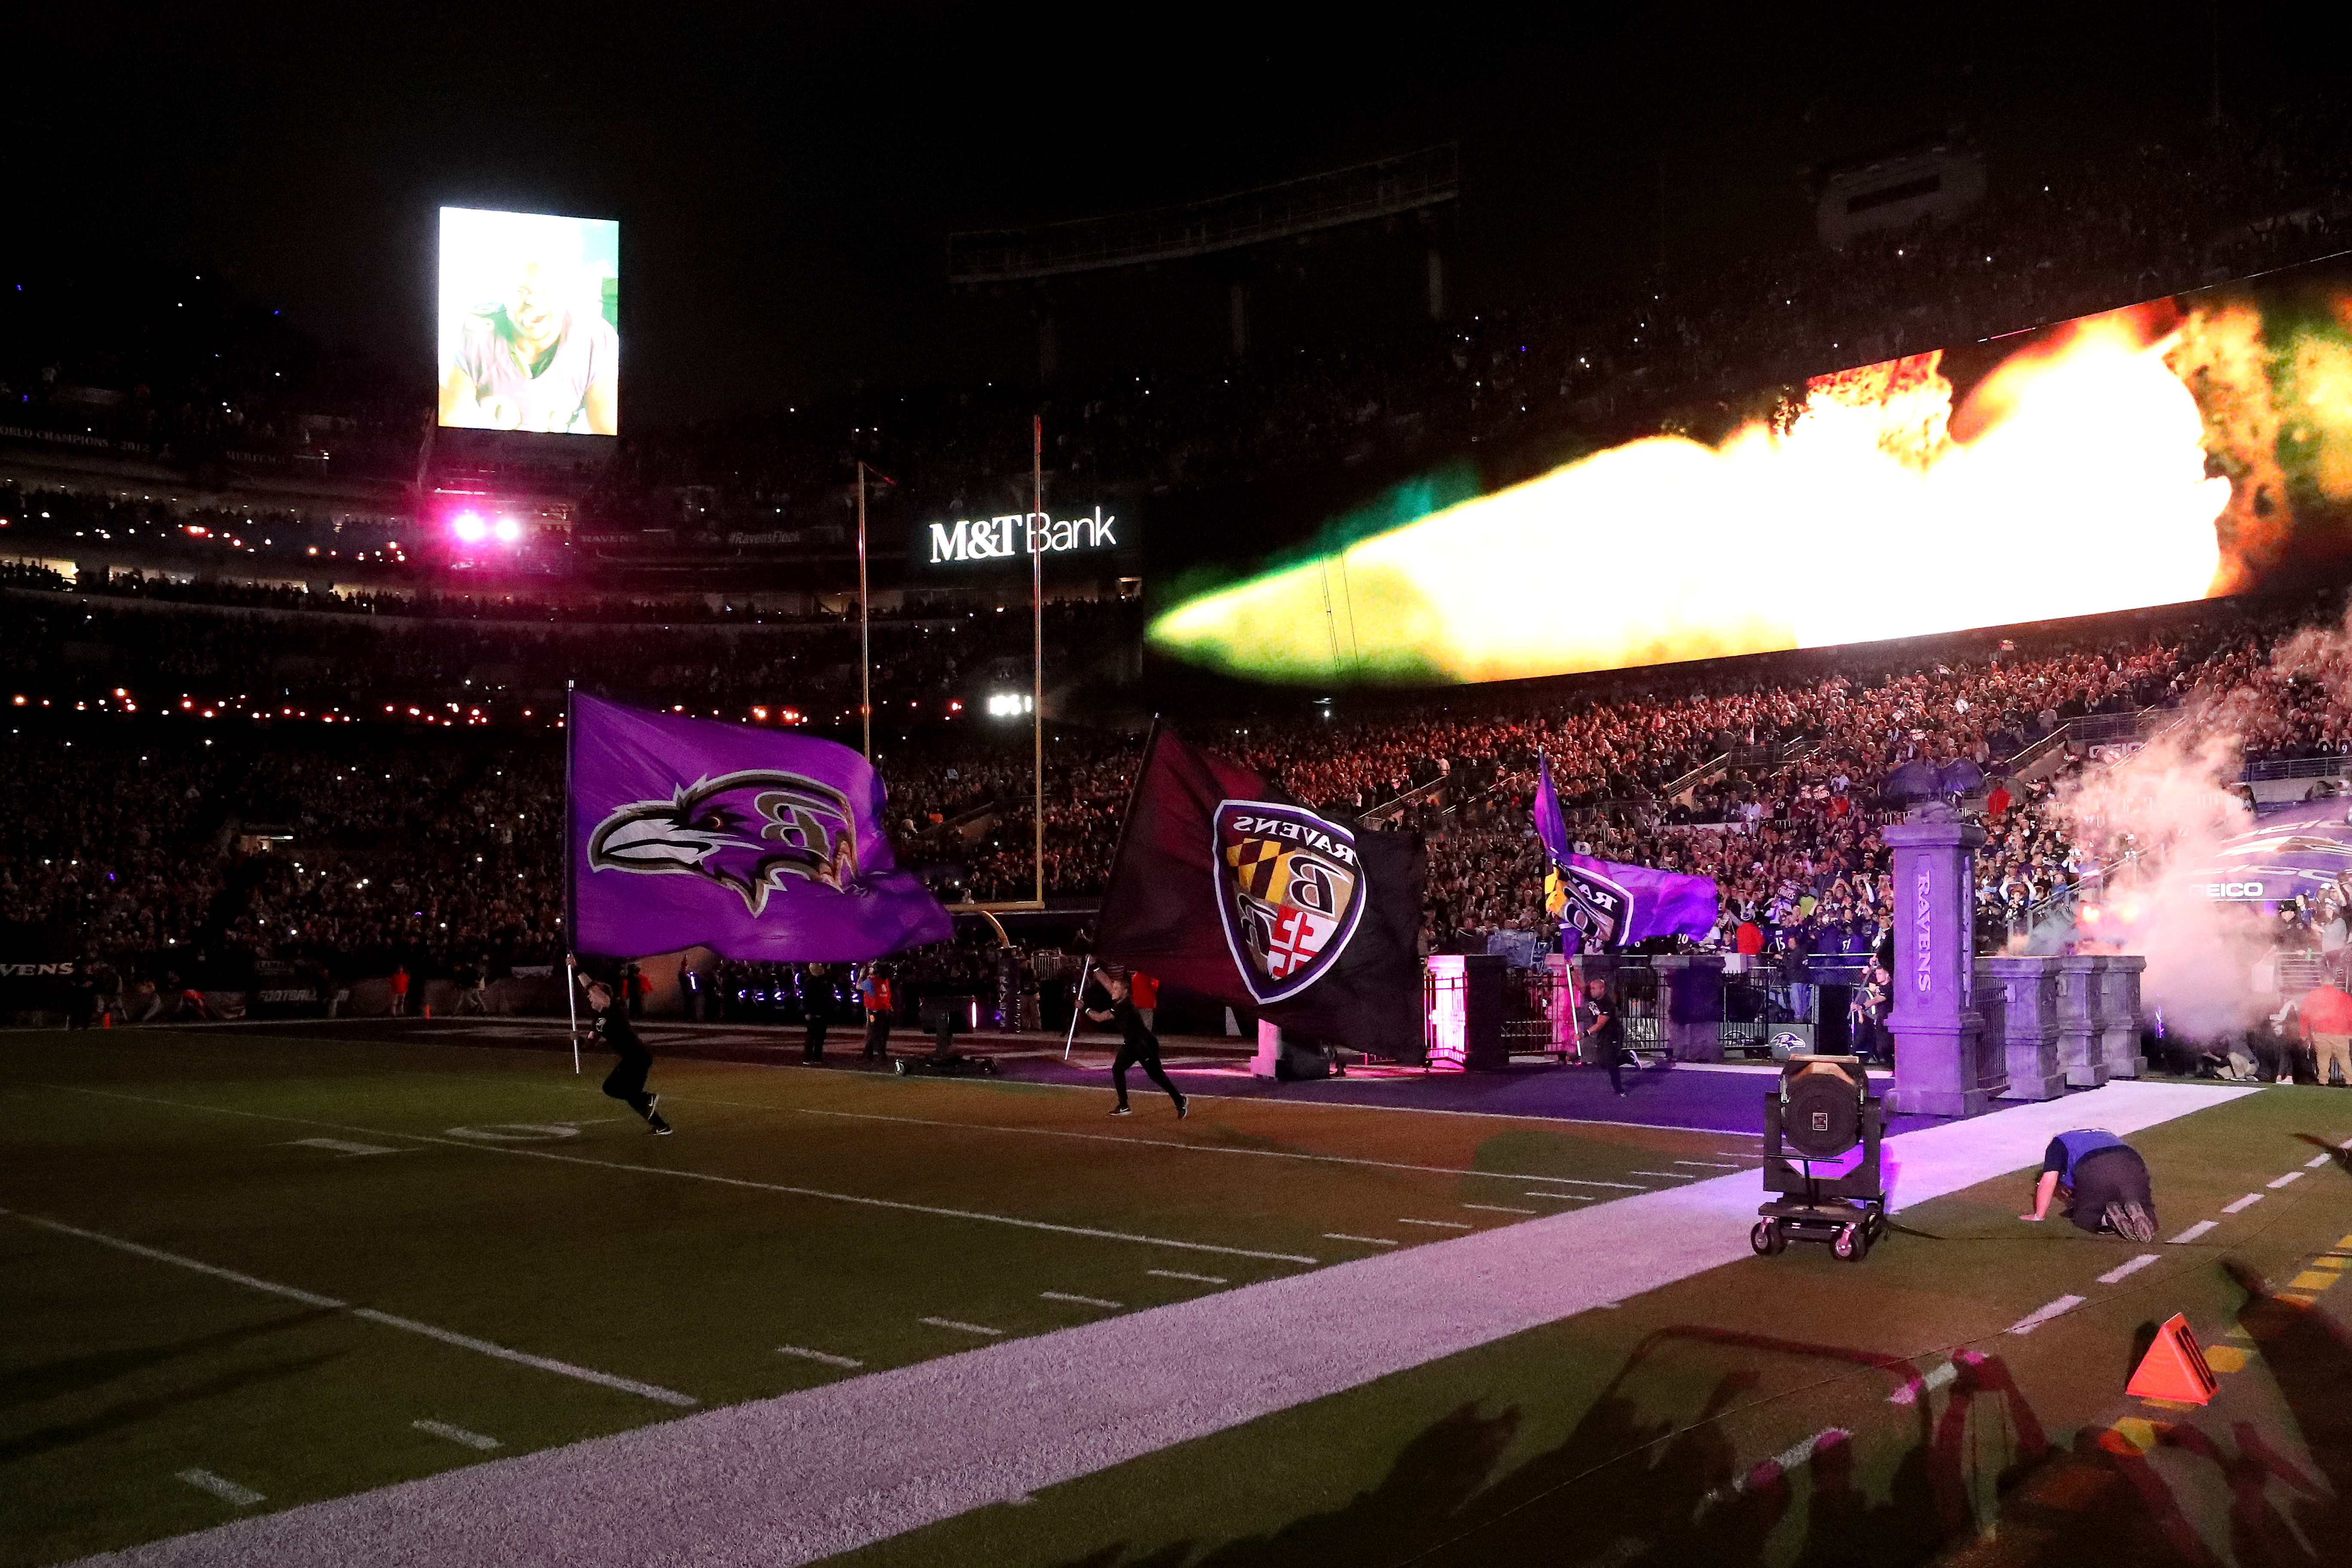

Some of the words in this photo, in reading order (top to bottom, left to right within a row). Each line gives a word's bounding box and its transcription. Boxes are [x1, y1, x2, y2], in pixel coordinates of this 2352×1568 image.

[36, 430, 108, 447] CHAMPIONS
[120, 440, 150, 453] 2012
[729, 530, 800, 545] #RavensFlock
[929, 515, 1023, 563] M&T
[1027, 506, 1116, 554] Bank
[1776, 801, 1785, 809] 29
[1917, 870, 1931, 992] RAVENS
[1776, 937, 1785, 952] 15
[0, 962, 74, 977] VENS
[257, 988, 318, 1002] FOOTBALL
